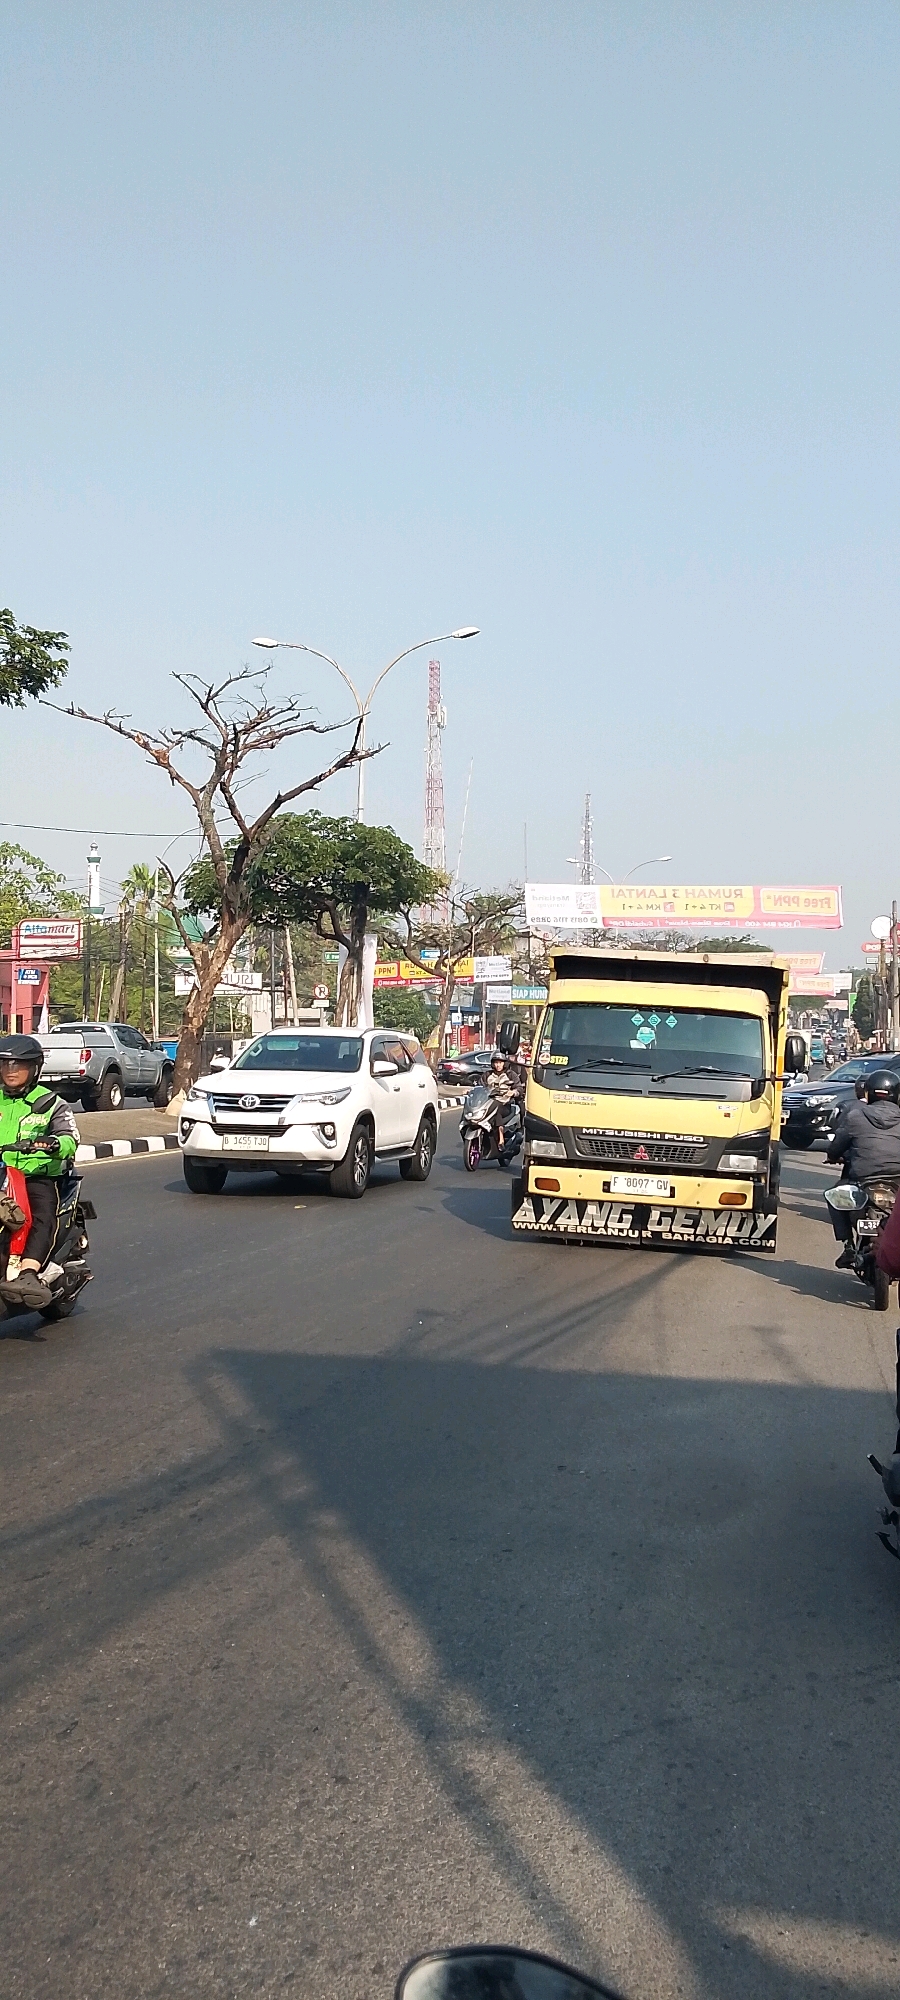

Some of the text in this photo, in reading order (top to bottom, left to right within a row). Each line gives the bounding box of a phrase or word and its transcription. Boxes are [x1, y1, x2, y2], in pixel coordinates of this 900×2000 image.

[24, 924, 75, 934] Alfamart
[512, 988, 529, 1000] SIAP
[582, 1127, 704, 1142] MITSUBISHI FUSO
[612, 1176, 619, 1187] F
[626, 1178, 650, 1189] 8097
[656, 1179, 669, 1191] GV
[511, 1196, 636, 1230] AYANG
[661, 1231, 776, 1248] BAHAGIA.COM
